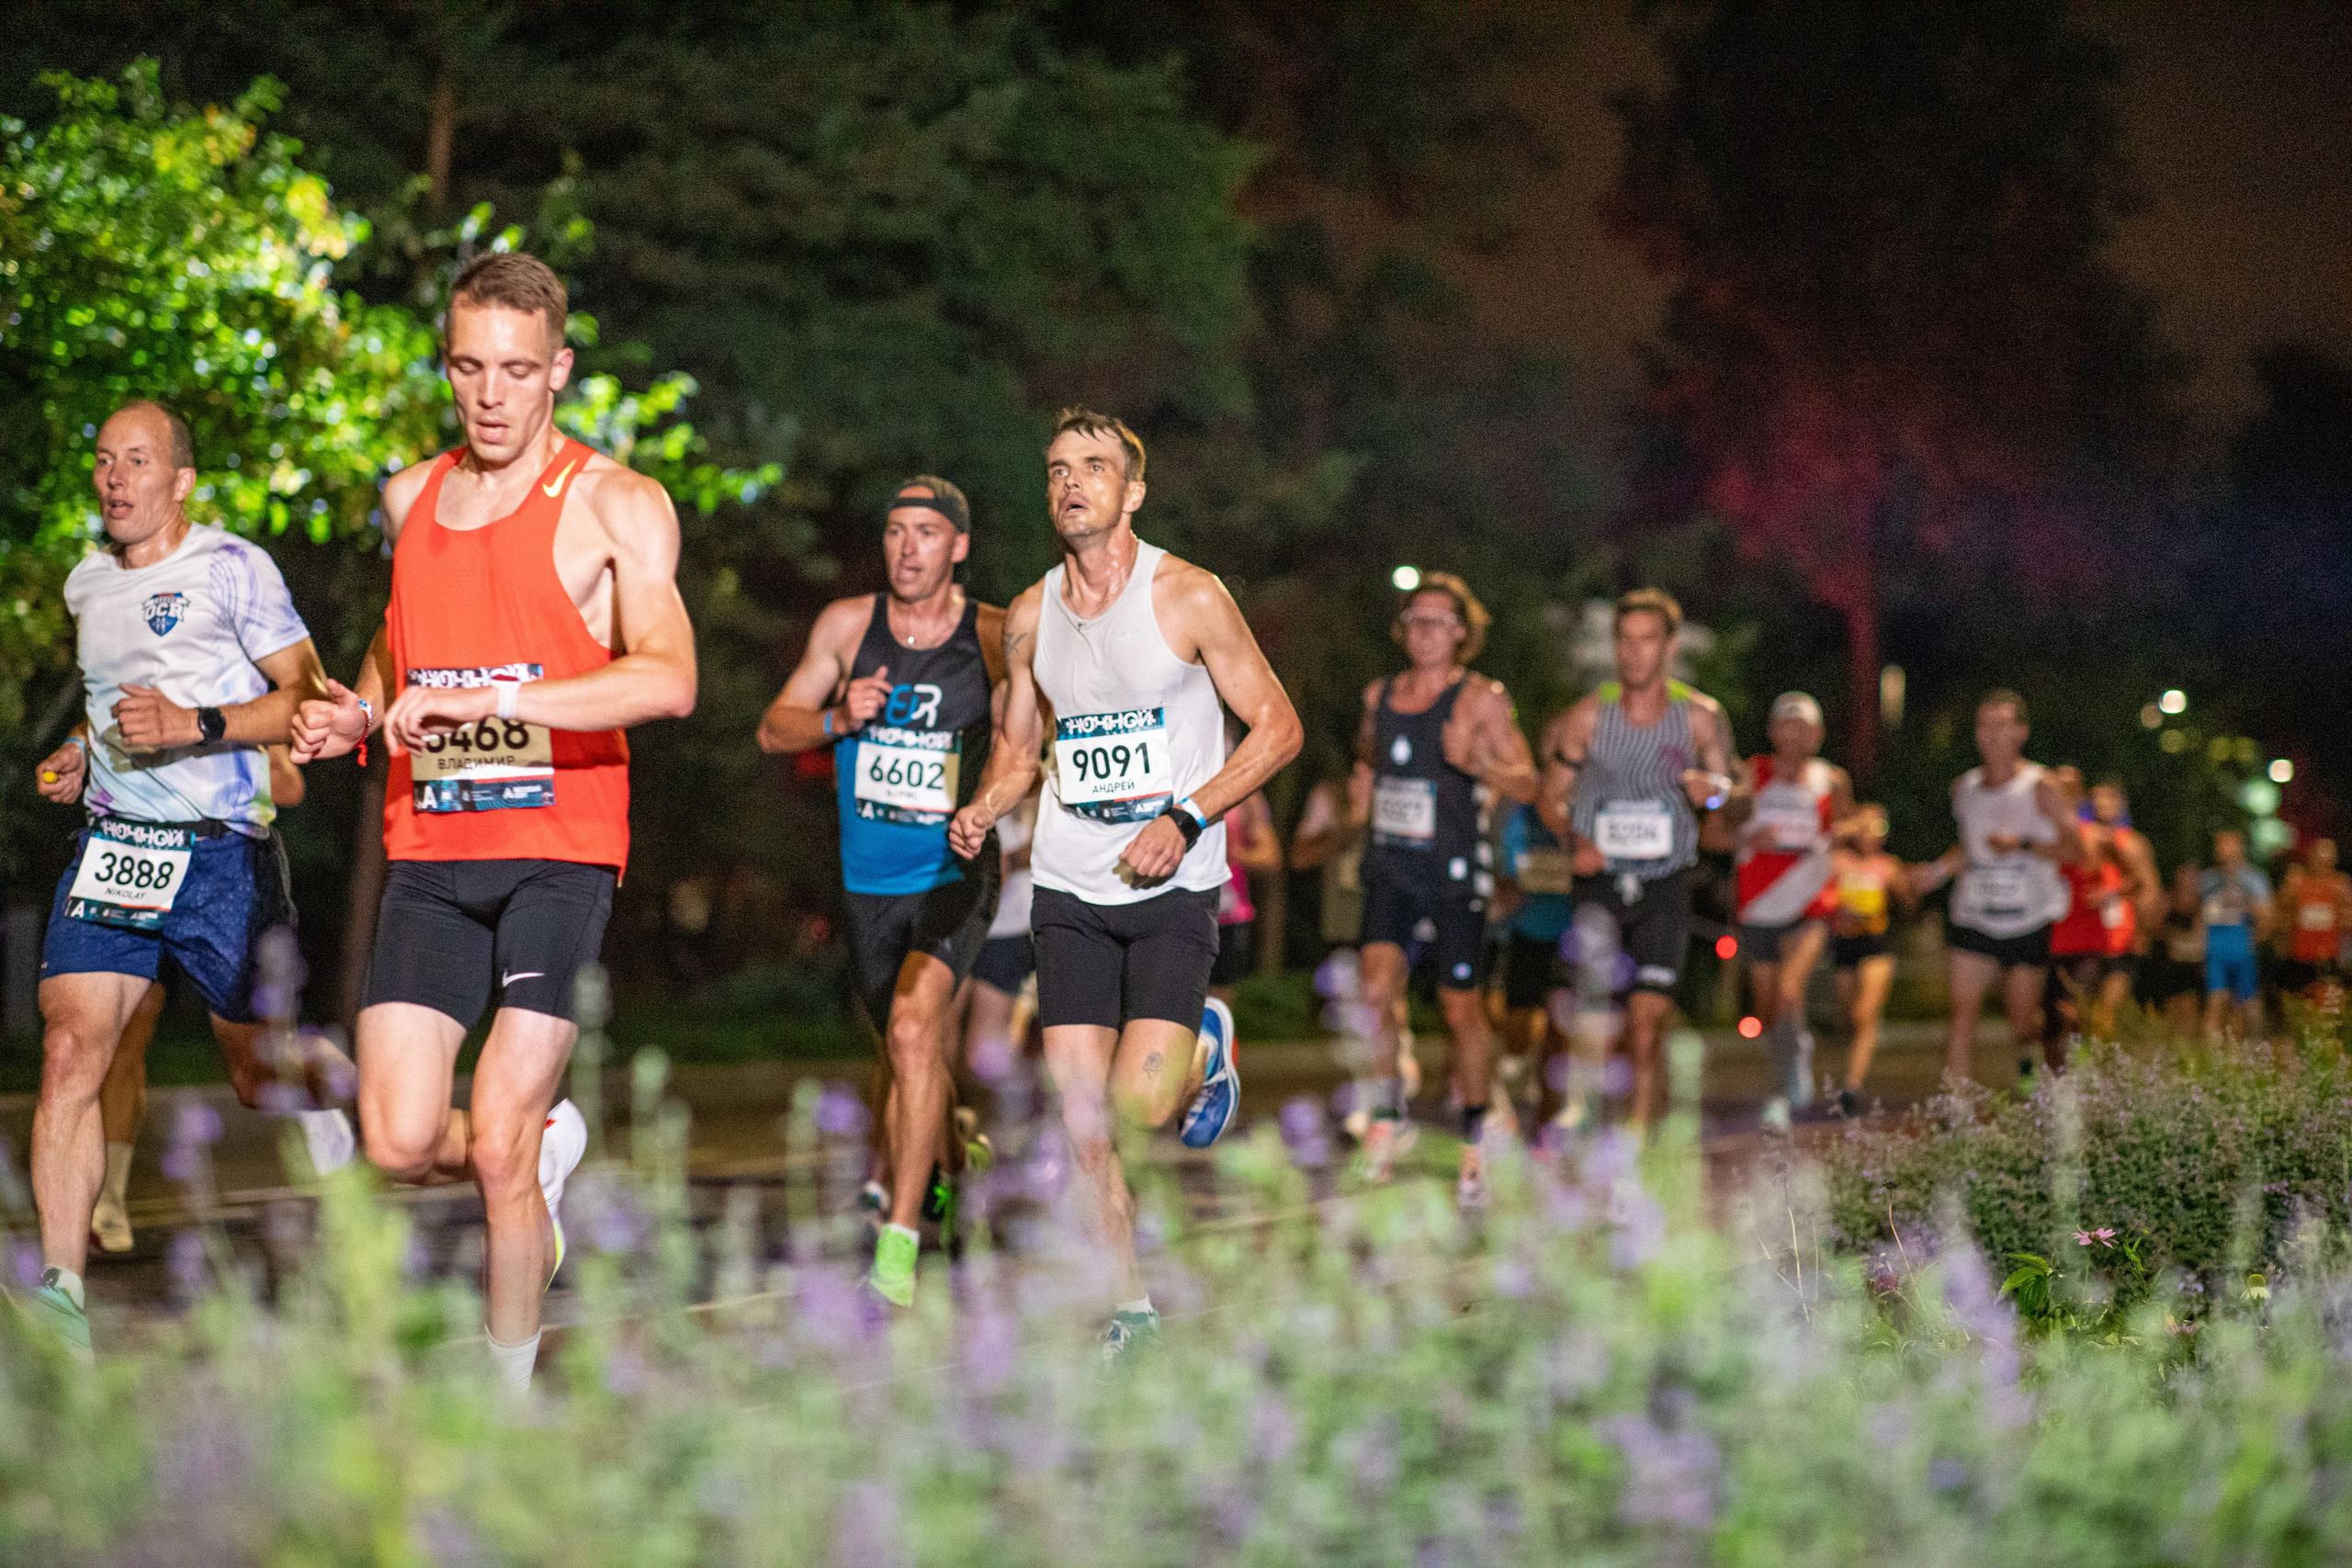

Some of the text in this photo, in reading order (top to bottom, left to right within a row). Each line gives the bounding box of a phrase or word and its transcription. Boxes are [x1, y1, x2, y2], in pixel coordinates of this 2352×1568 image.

[1066, 709, 1156, 735] НОЧНОЙ
[869, 754, 945, 790] 6602
[1072, 741, 1150, 782] 9091
[1091, 780, 1136, 795] АНДРЕЙ
[101, 819, 185, 848] НОЧНОЙ
[95, 852, 175, 890] 3888
[105, 887, 148, 901] NIKOLAY
